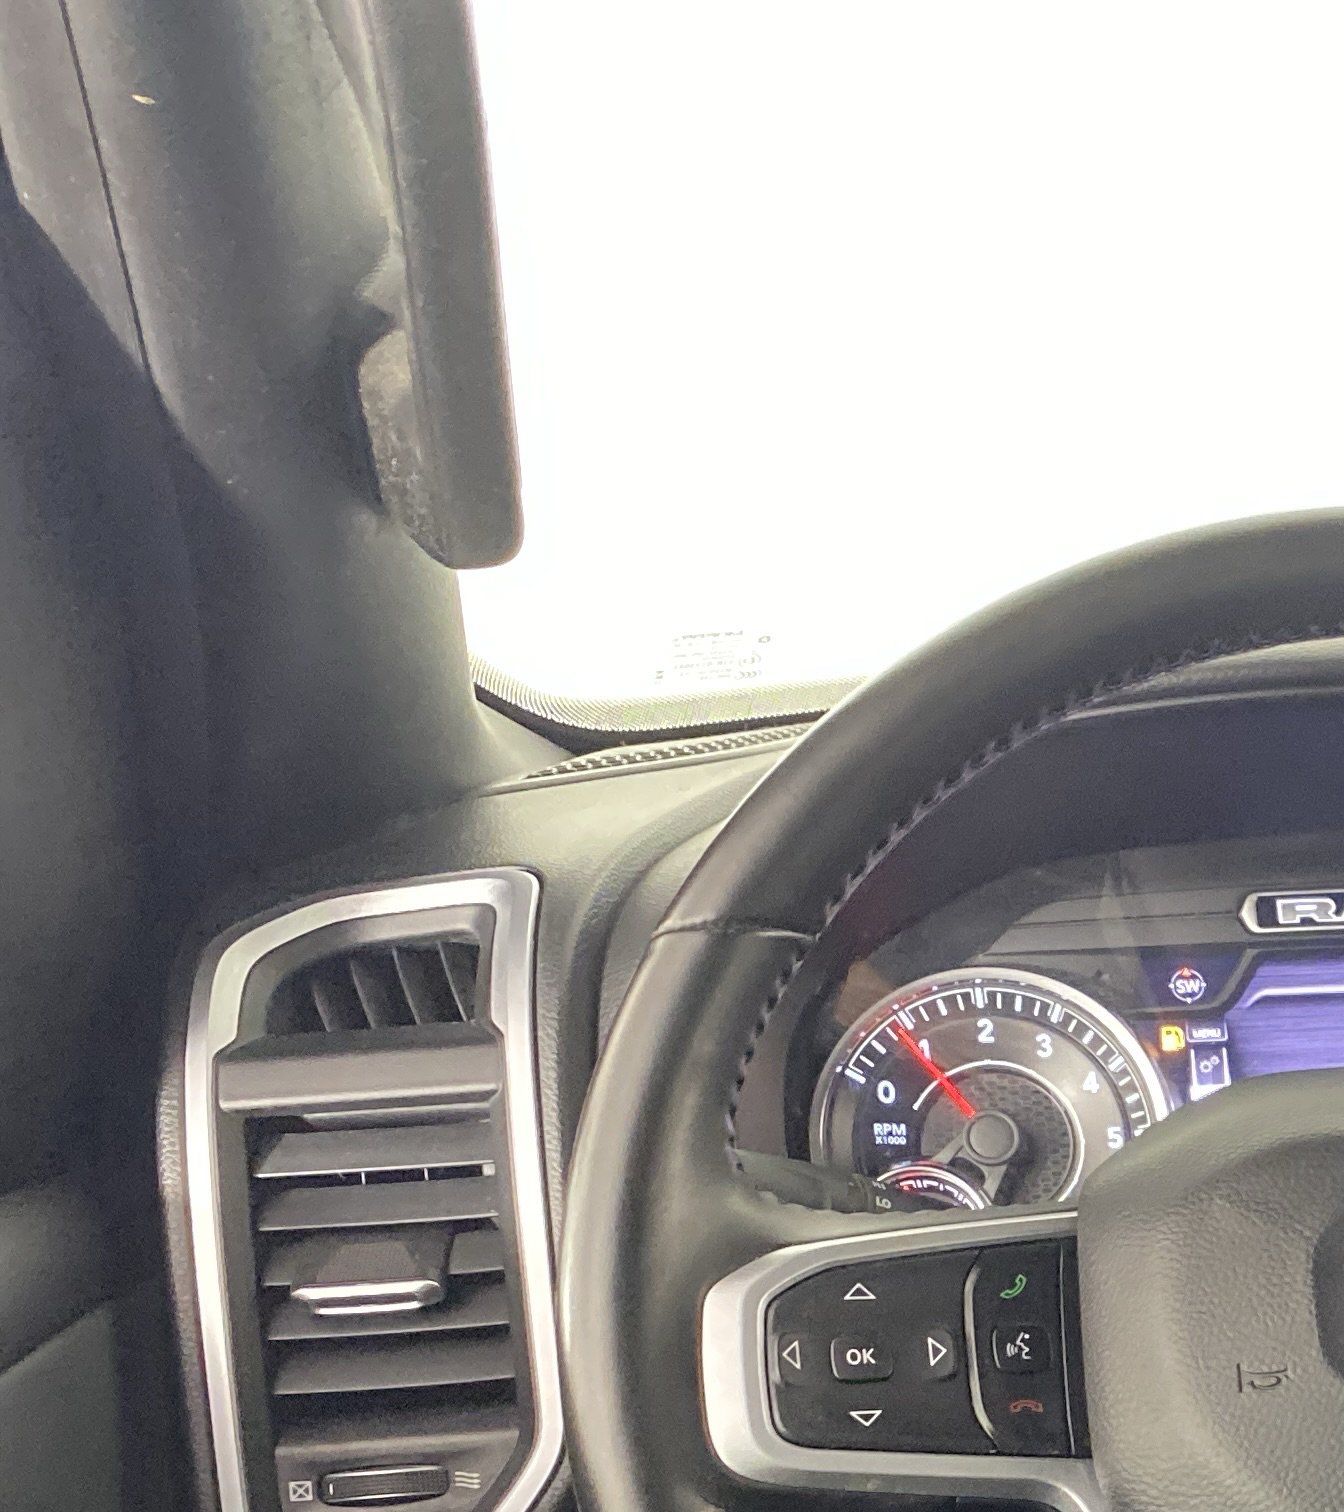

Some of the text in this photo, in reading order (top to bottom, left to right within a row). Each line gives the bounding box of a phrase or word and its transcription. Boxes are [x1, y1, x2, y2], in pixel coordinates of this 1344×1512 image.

[1175, 979, 1200, 994] SW
[976, 1019, 995, 1044] 2
[917, 1038, 932, 1061] 1
[1035, 1033, 1054, 1058] 3
[876, 1080, 897, 1104] 0
[1081, 1071, 1101, 1094] 4
[872, 1122, 908, 1137] RPM
[1107, 1126, 1126, 1150] 5
[846, 1348, 877, 1367] OK
